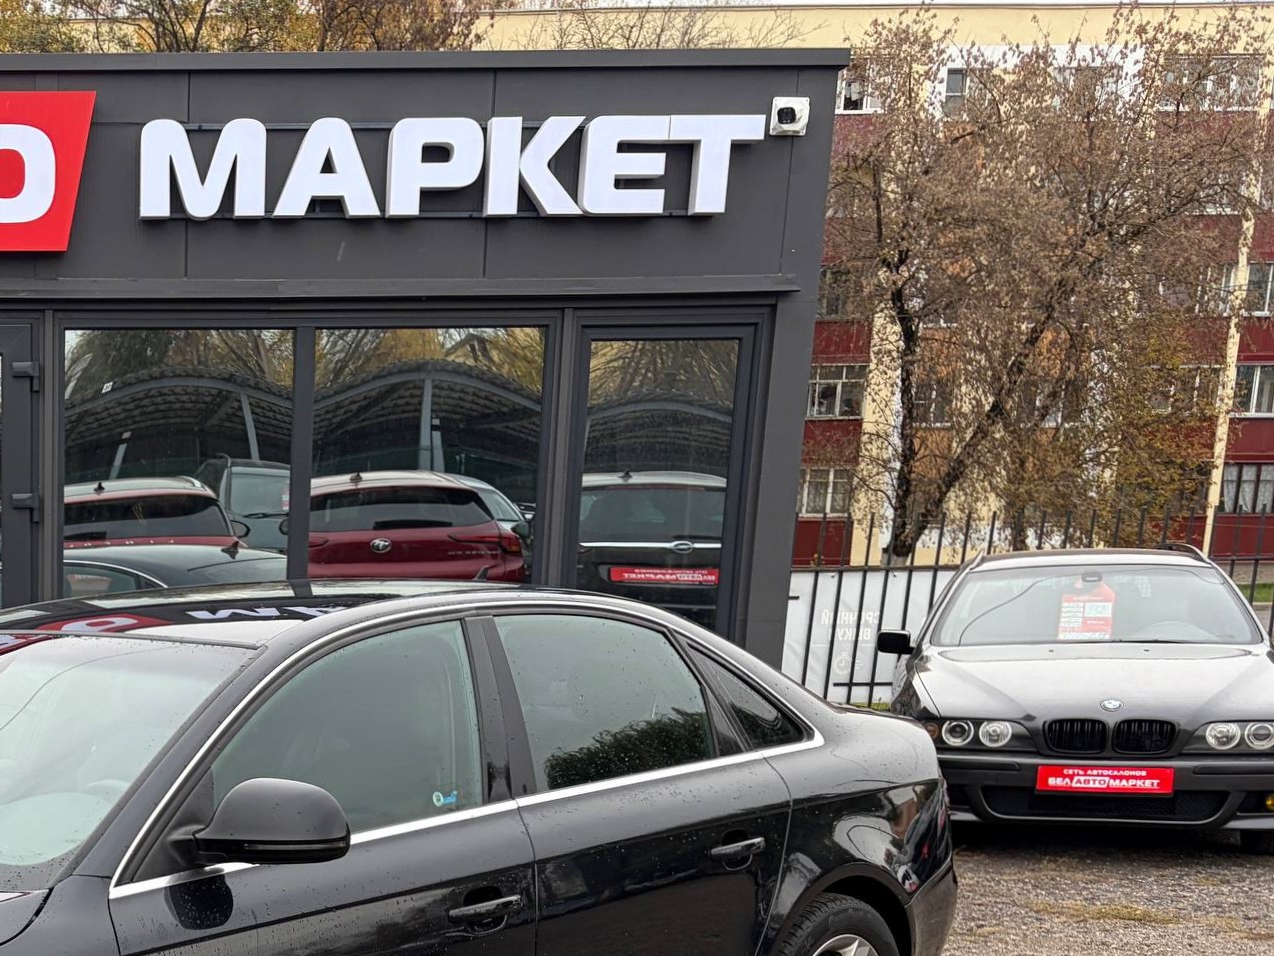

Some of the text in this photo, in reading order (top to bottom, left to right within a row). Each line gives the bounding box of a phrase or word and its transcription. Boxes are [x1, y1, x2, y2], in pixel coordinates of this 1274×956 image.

[138, 114, 766, 220] МАРКЕТ
[1063, 768, 1085, 776] СЕТЬ
[1048, 777, 1161, 787] БЕЛ АВТО МАРКЕТ
